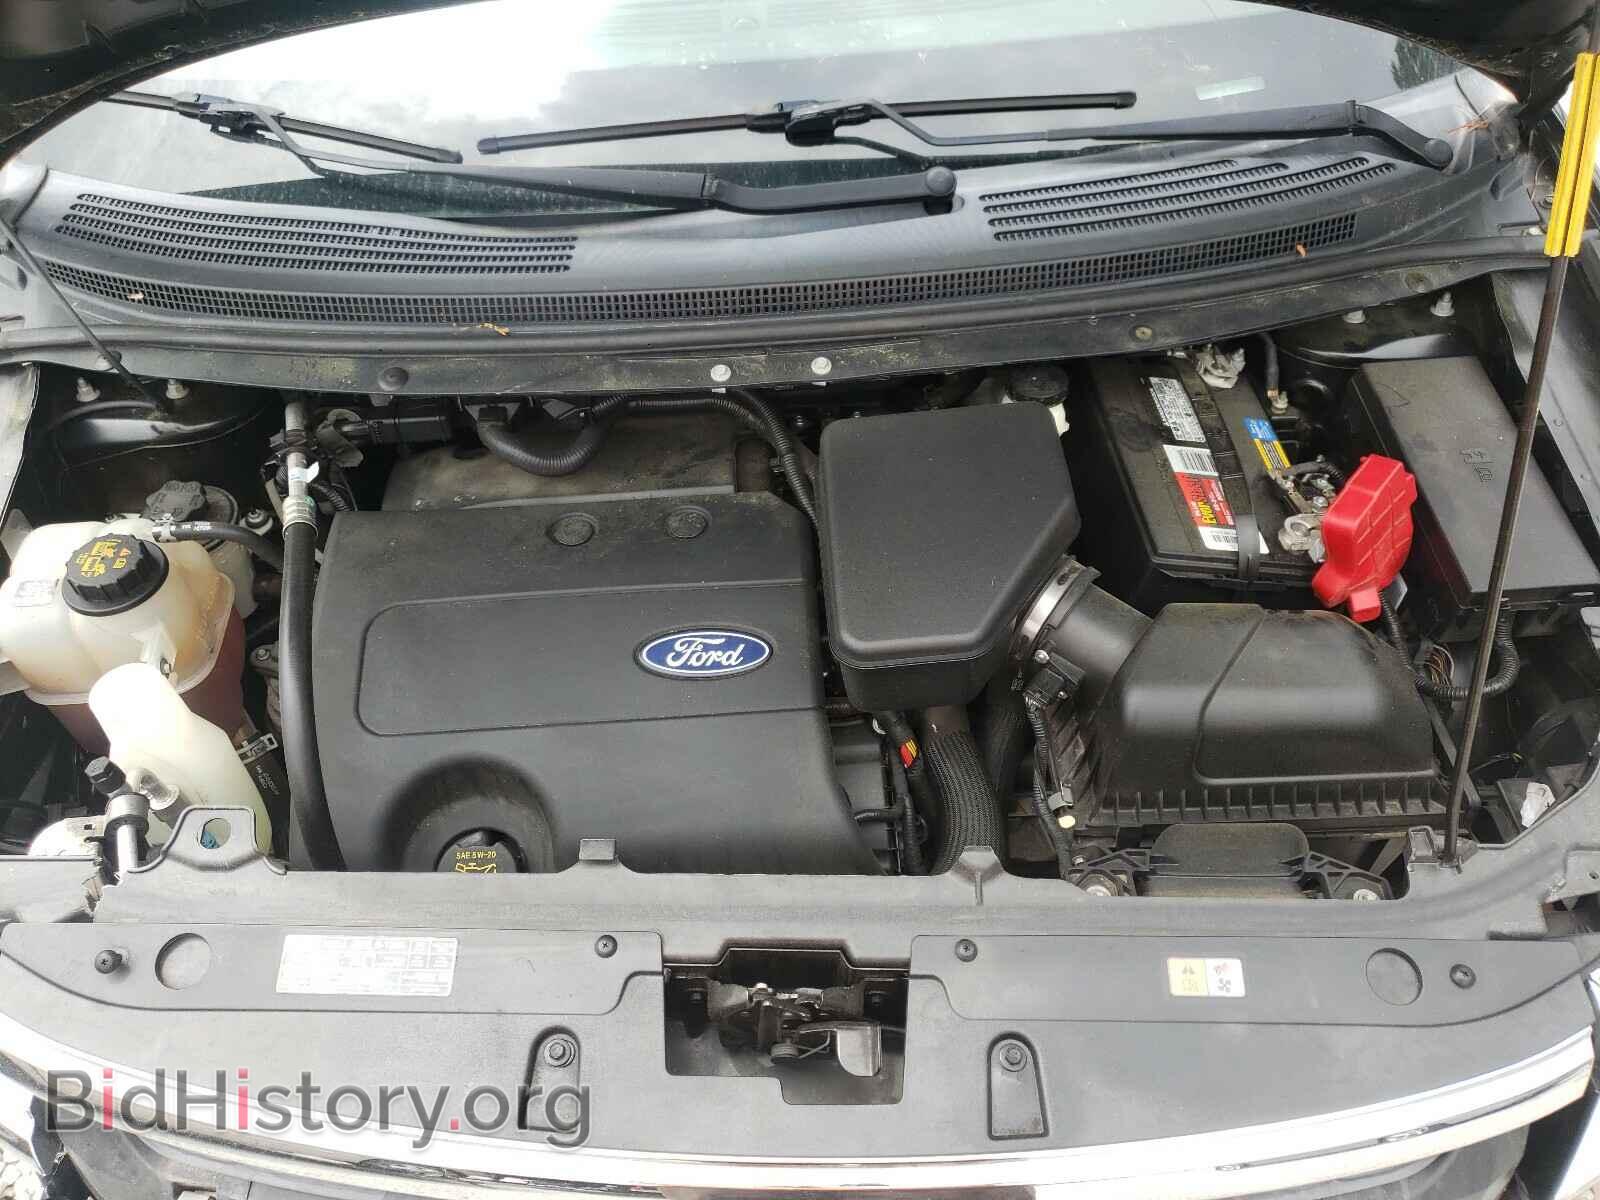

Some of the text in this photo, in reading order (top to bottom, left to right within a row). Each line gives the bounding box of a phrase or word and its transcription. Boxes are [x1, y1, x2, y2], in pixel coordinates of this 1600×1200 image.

[666, 637, 745, 667] Ford
[455, 851, 496, 860] SAE 5W-20
